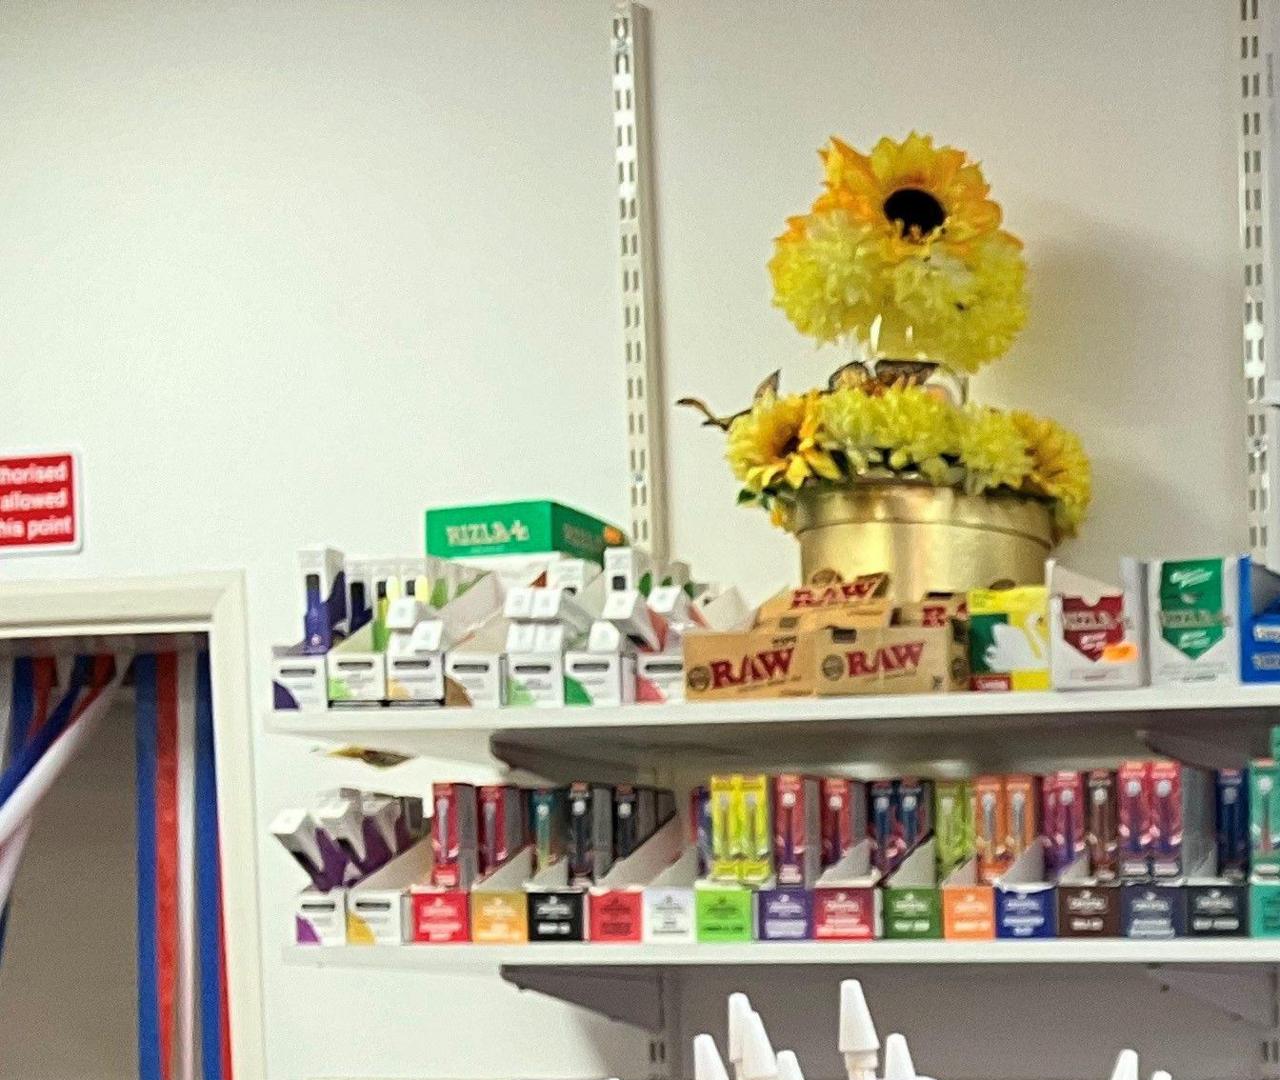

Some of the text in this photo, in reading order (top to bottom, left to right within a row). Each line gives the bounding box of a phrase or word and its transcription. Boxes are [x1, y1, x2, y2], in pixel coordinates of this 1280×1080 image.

[0, 487, 69, 511] allowed
[0, 514, 72, 541] his point
[791, 573, 882, 608] RAW
[711, 647, 795, 689] RAW
[846, 642, 924, 677] RAW
